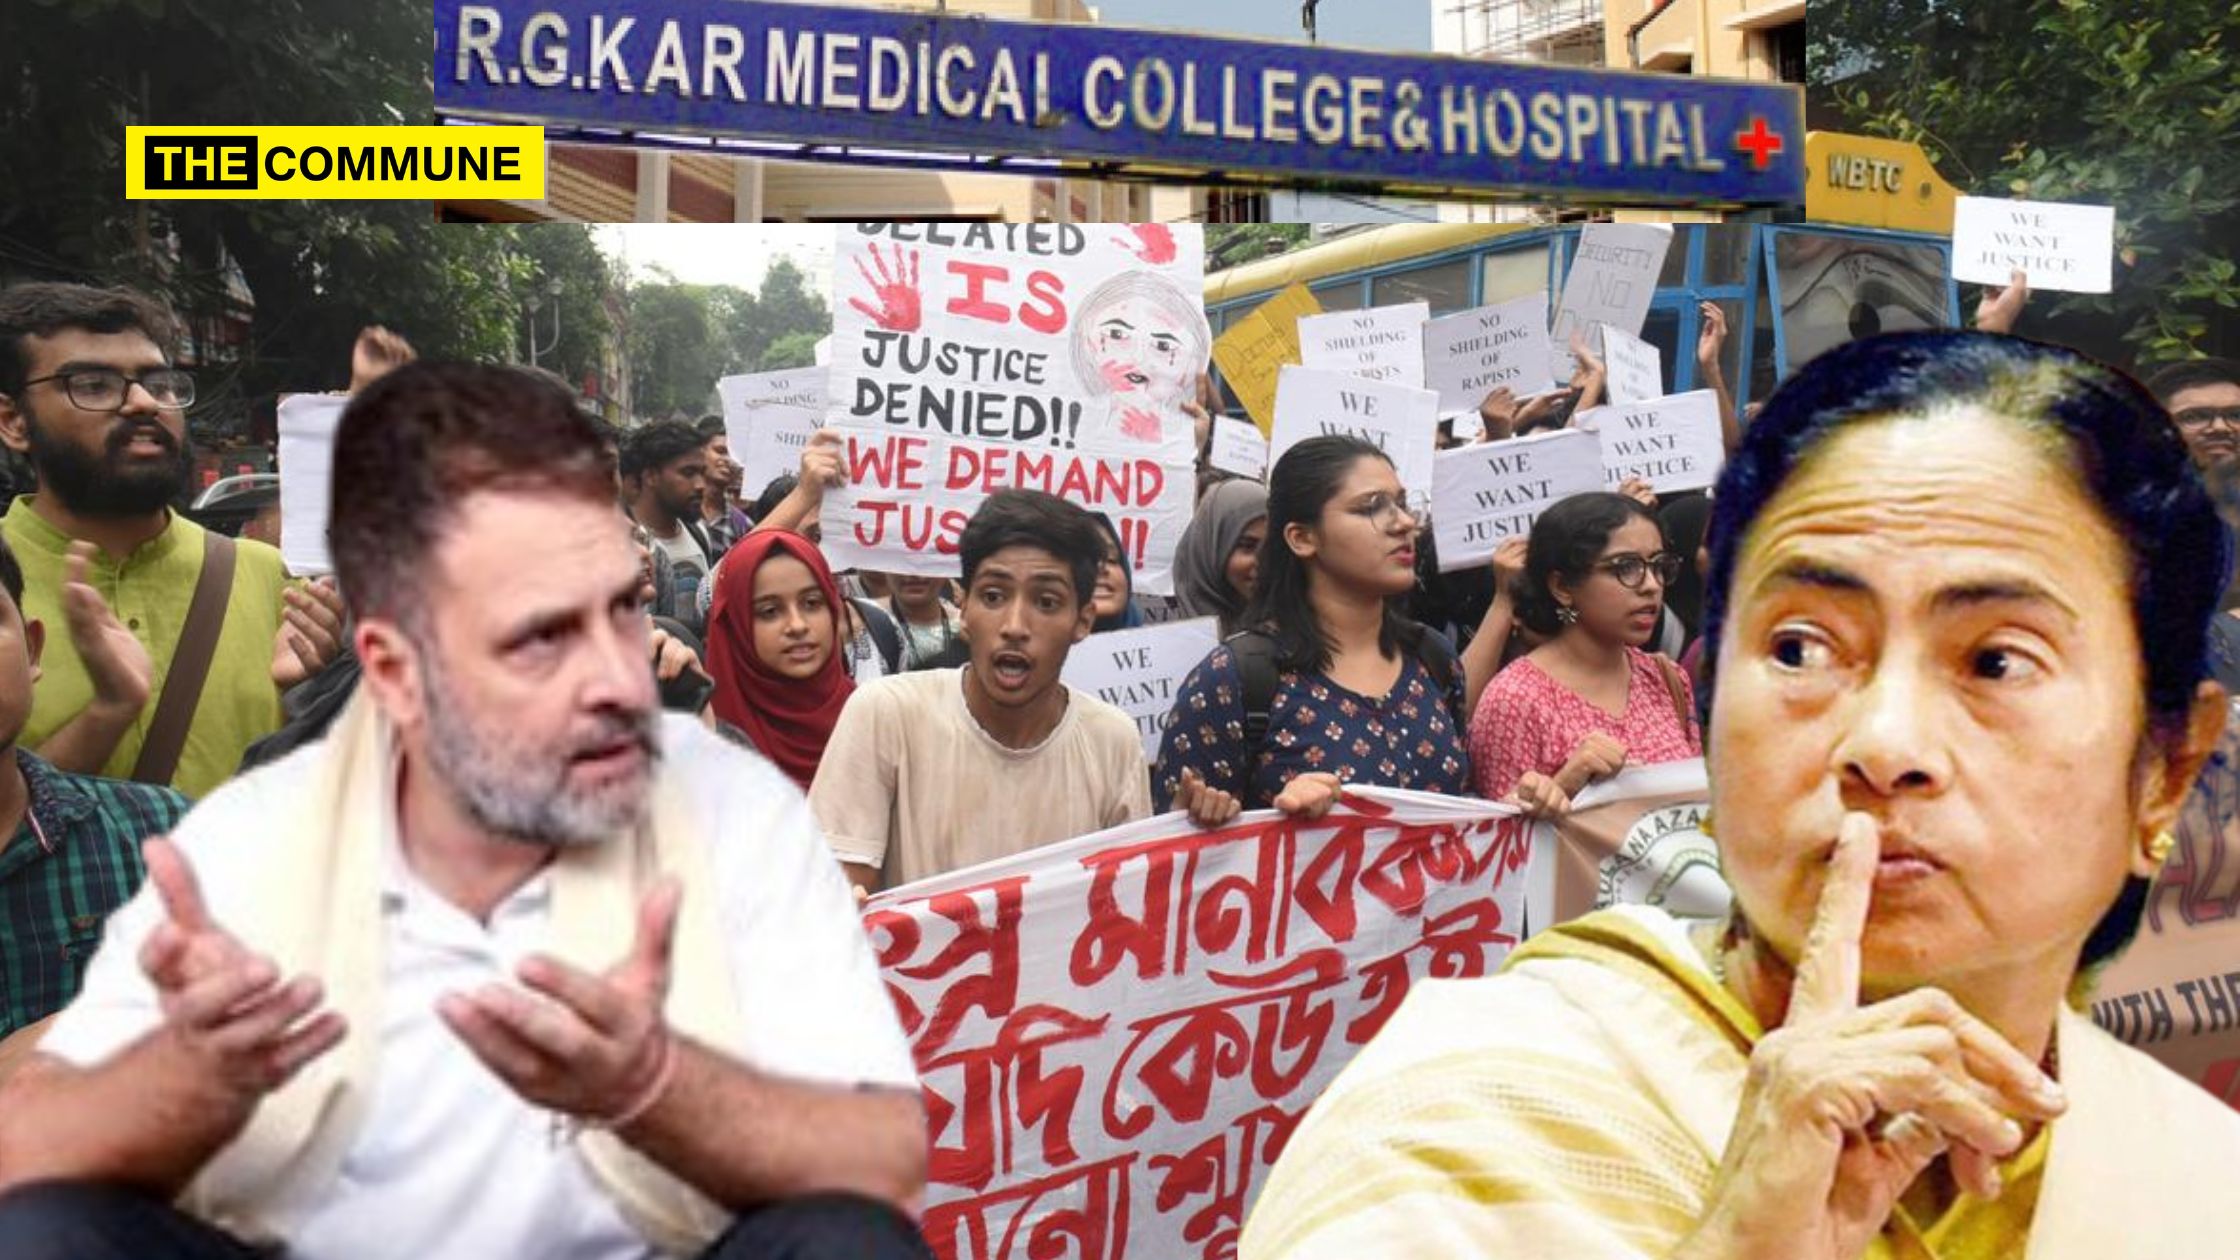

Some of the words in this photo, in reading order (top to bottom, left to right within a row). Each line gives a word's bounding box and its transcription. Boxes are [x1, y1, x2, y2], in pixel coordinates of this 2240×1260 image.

[765, 26, 1063, 126] MEDICAL
[1828, 153, 1903, 194] WBTC
[2011, 212, 2049, 228] WE
[1994, 231, 2067, 250] WANT
[1977, 250, 2076, 273] JUSTICE
[946, 260, 1068, 335] IS
[1353, 317, 1375, 331] NO
[1479, 314, 1500, 328] NO
[1324, 331, 1406, 351] SHIELDING
[1449, 327, 1528, 355] SHIELDING
[862, 330, 1049, 386] JUSTICE
[1481, 351, 1500, 367] OF
[1461, 366, 1521, 392] RAPISTS
[850, 378, 1082, 449] DENIED!!
[1339, 391, 1378, 417] WE
[1625, 411, 1661, 430] WE
[1614, 433, 1679, 456] WANT
[848, 435, 928, 490] WE
[945, 446, 1165, 507] DEMAND
[1487, 452, 1532, 476] WE
[1474, 479, 1553, 509] WANT
[1462, 512, 1536, 543] JUSTI
[1112, 648, 1152, 671] WE
[1098, 677, 1173, 705] WANT
